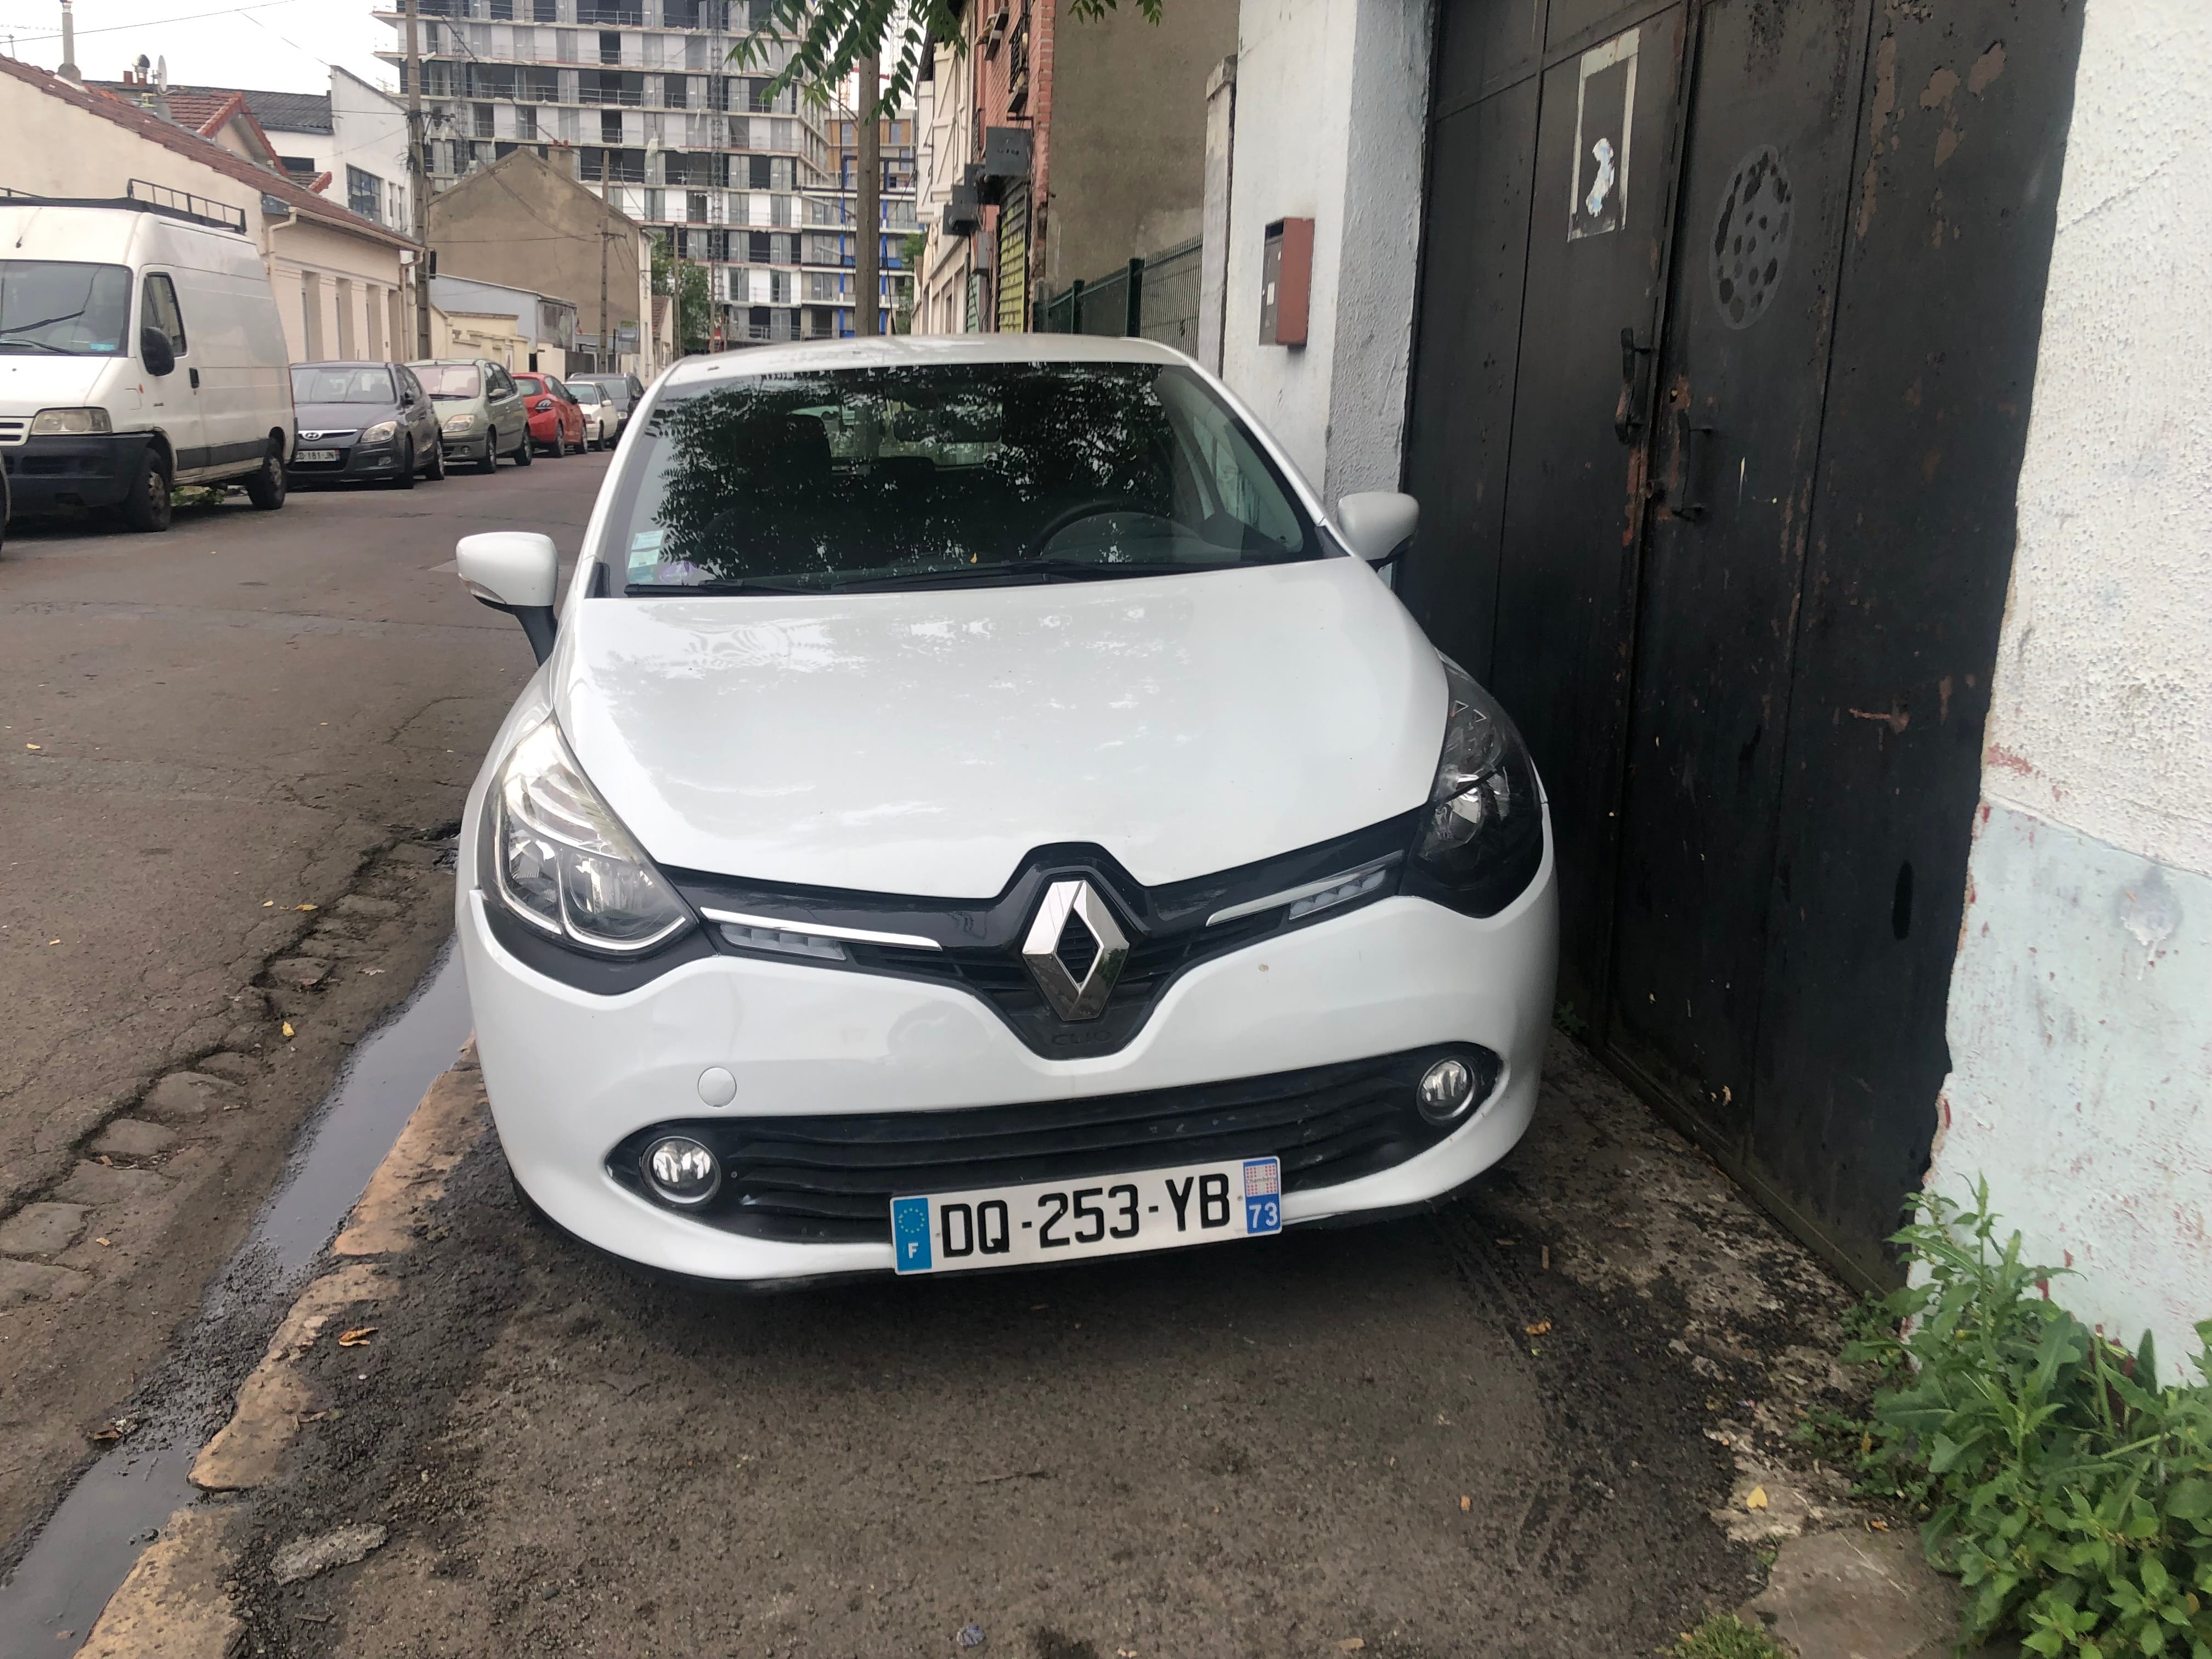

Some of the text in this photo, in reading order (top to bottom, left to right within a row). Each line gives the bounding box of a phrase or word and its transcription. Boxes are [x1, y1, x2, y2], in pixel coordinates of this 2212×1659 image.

[1051, 1031, 1111, 1046] CLIO
[940, 1173, 1230, 1257] DQ-253-YB
[1249, 1202, 1278, 1228] 73
[908, 1243, 919, 1259] F
